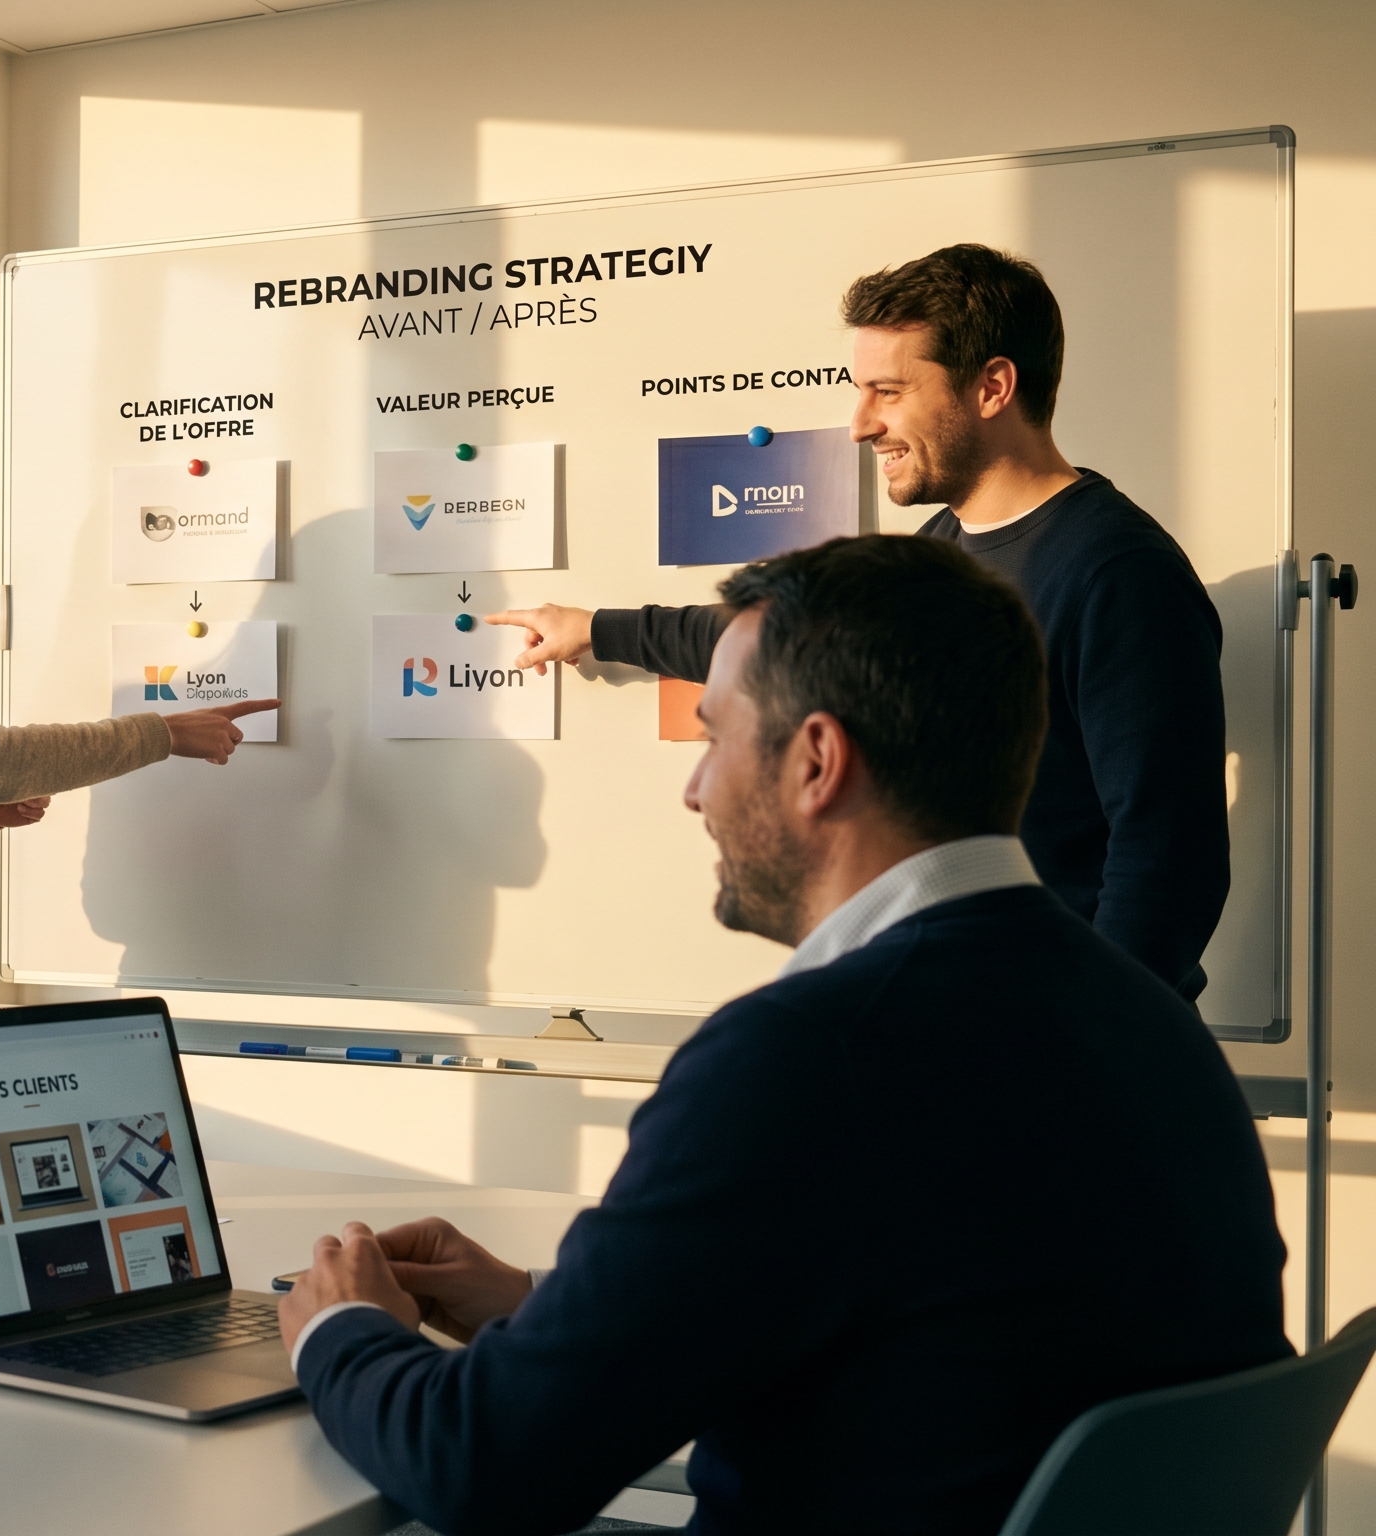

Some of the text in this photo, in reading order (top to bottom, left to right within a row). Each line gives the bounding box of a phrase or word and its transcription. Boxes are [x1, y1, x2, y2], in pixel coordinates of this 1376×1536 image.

[254, 244, 713, 309] REBRANDING STRATEGIY
[358, 293, 598, 340] AVANT / APRÈS
[641, 374, 726, 397] POINTS
[733, 372, 764, 391] DE
[119, 393, 274, 419] CLARIFICATION
[376, 386, 555, 414] VALEUR PERÇUE
[139, 419, 254, 442] DE L’OFFRE
[187, 671, 226, 688] Lyon
[449, 663, 524, 692] Liyon
[12, 1073, 79, 1097] CLIENTS
